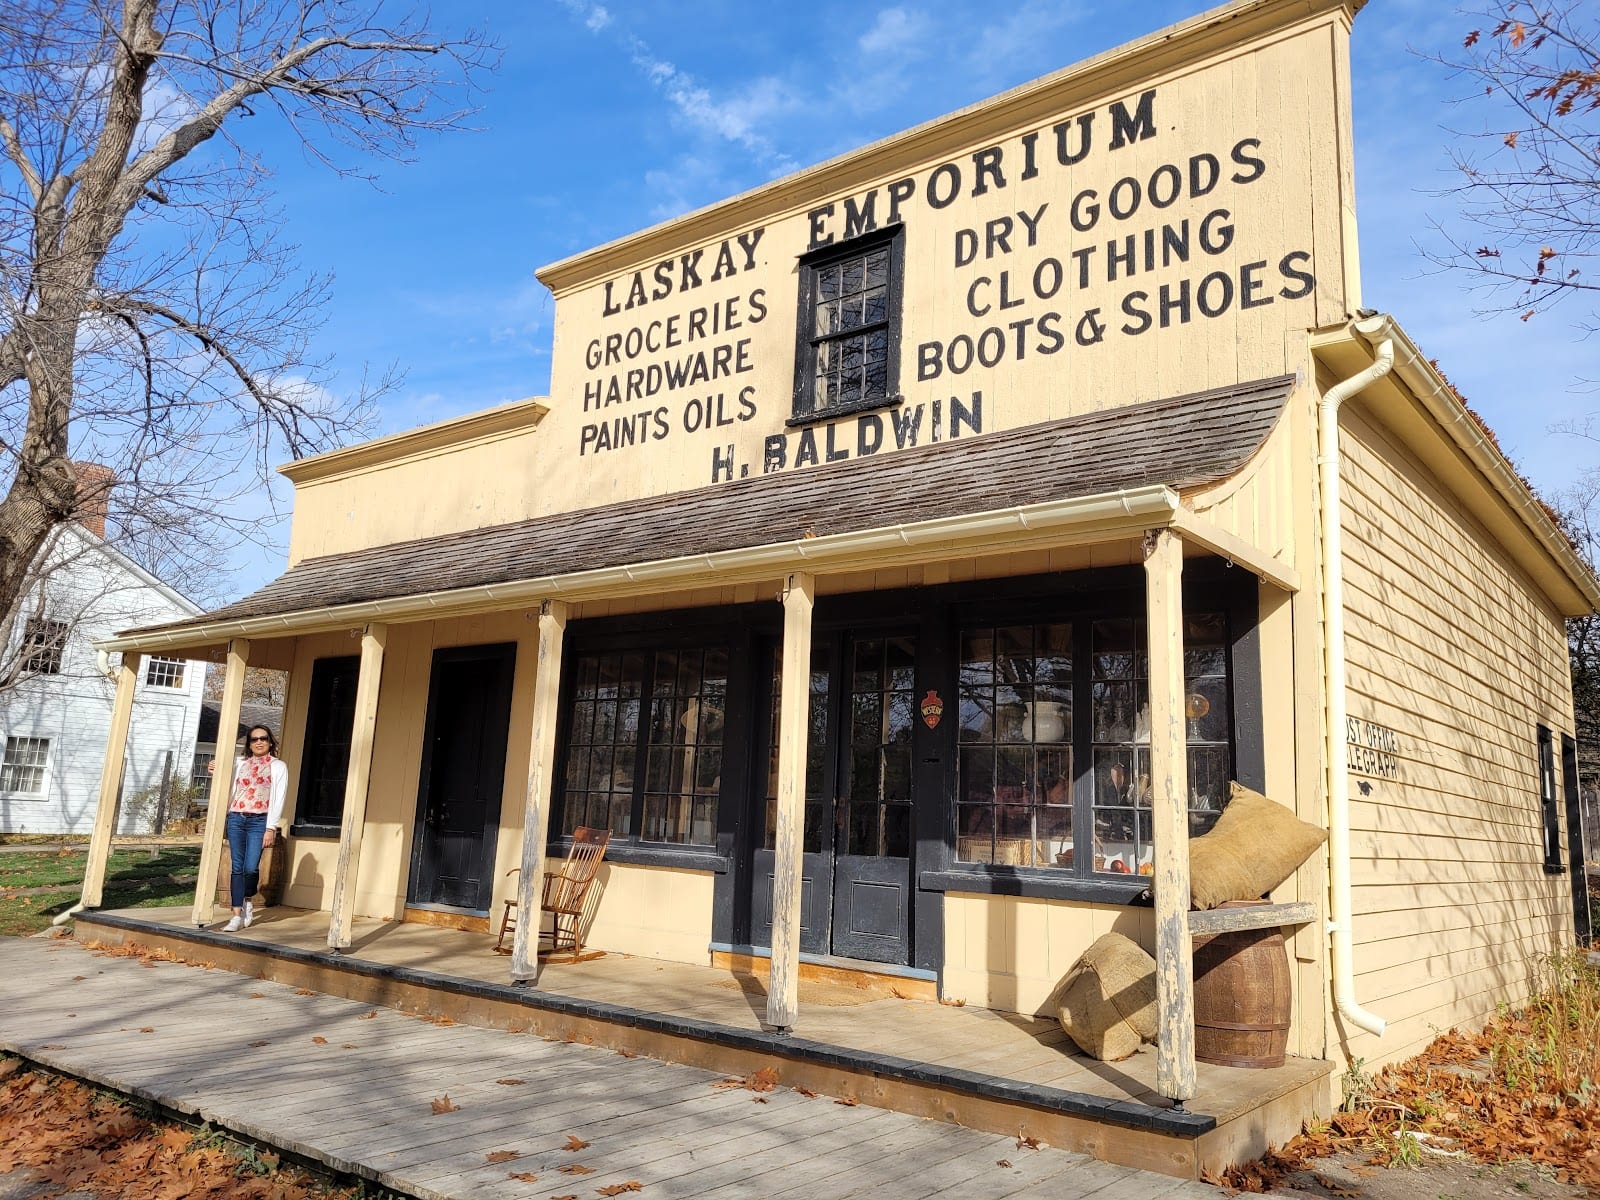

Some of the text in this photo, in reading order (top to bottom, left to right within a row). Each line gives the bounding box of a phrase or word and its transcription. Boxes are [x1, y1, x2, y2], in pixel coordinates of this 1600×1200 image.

[602, 90, 1157, 319] LASKAY EMPORIUM
[955, 138, 1266, 268] DRY GOODS
[967, 208, 1235, 317] CLOTHING
[585, 288, 768, 371] GROCERIES
[917, 250, 1314, 382] BOOTS & SHOES
[583, 337, 754, 413] HARDWARE
[579, 385, 758, 456] PAINTS OILS
[711, 390, 983, 484] H. BALDWIN
[1347, 745, 1398, 779] LEGRAPH
[1366, 722, 1398, 753] OFFICE
